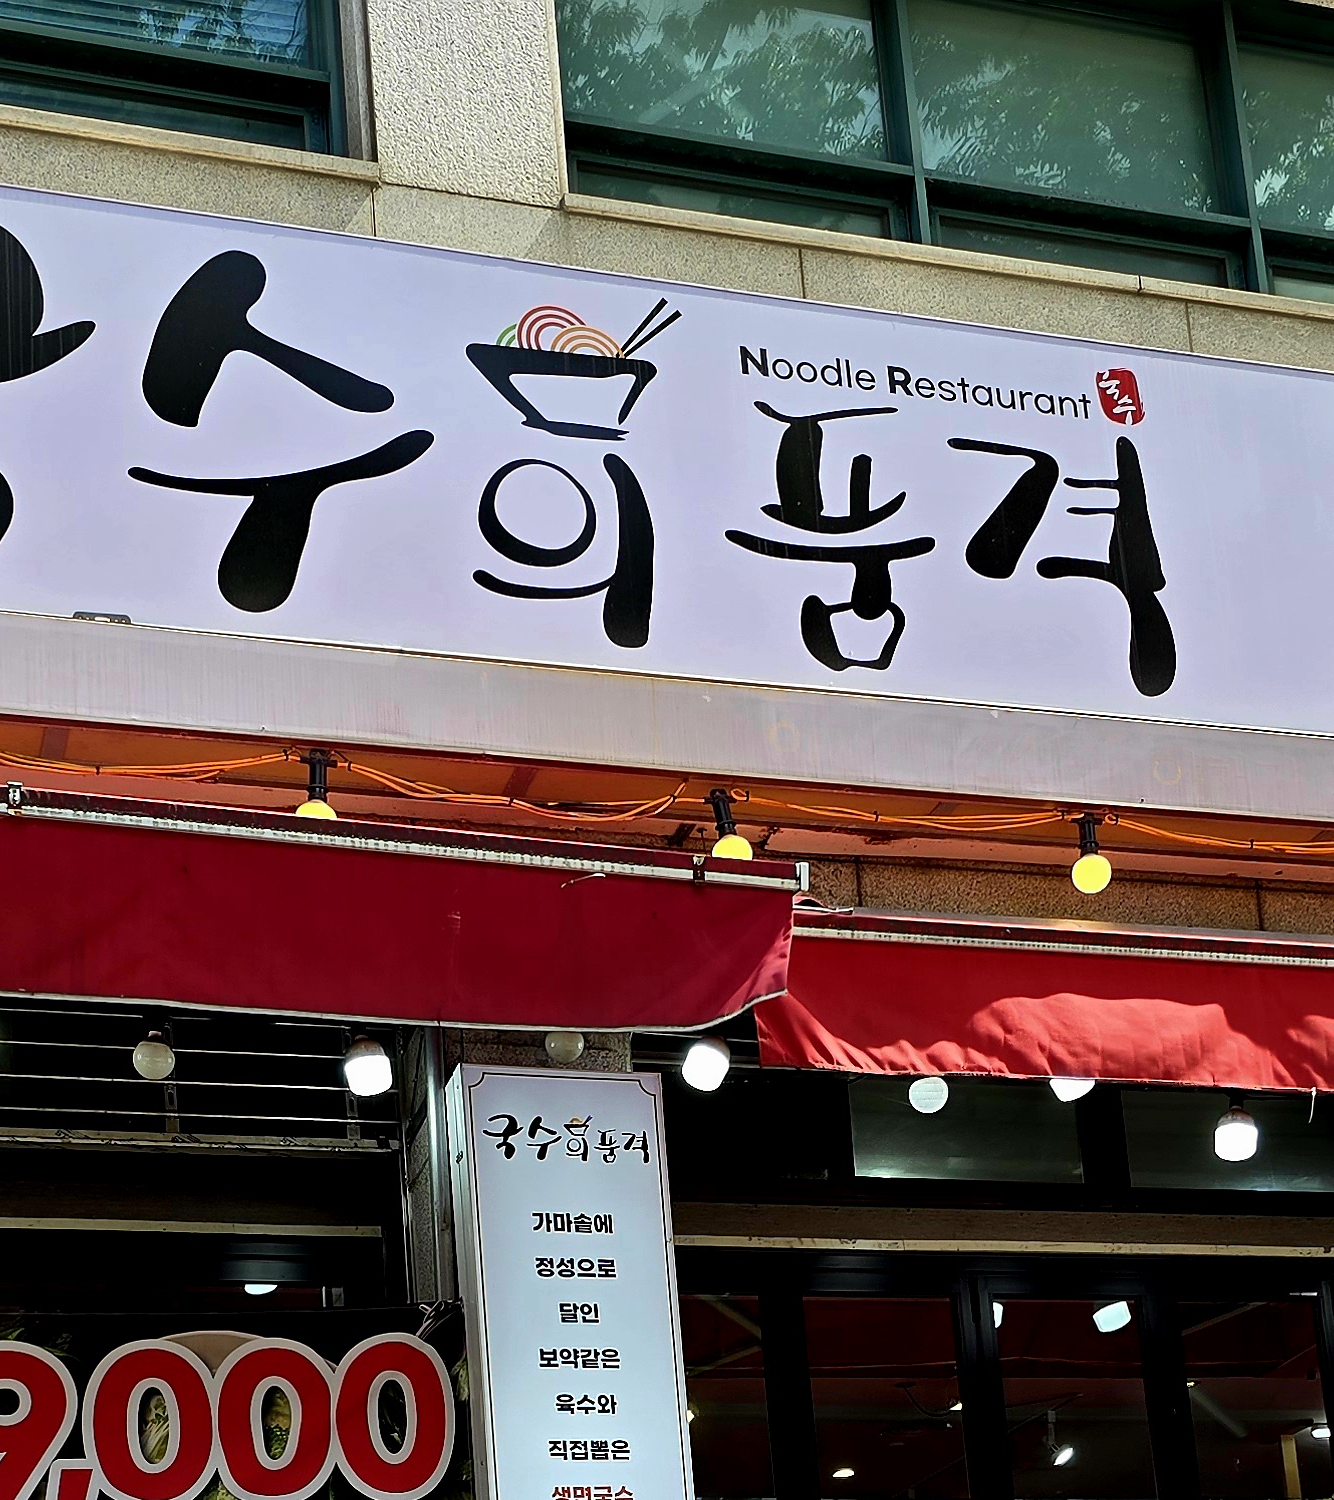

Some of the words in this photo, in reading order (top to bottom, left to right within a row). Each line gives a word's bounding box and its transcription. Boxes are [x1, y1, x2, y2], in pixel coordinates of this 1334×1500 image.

[738, 344, 876, 391] Noodle
[886, 364, 1092, 420] Restaurant
[531, 1212, 614, 1234] 가마솥에
[534, 1257, 618, 1279] 정성으로
[558, 1302, 601, 1325] 달인
[538, 1347, 621, 1370] 보약같은
[555, 1393, 618, 1416] 육수와
[548, 1439, 632, 1461] 직접뽑은
